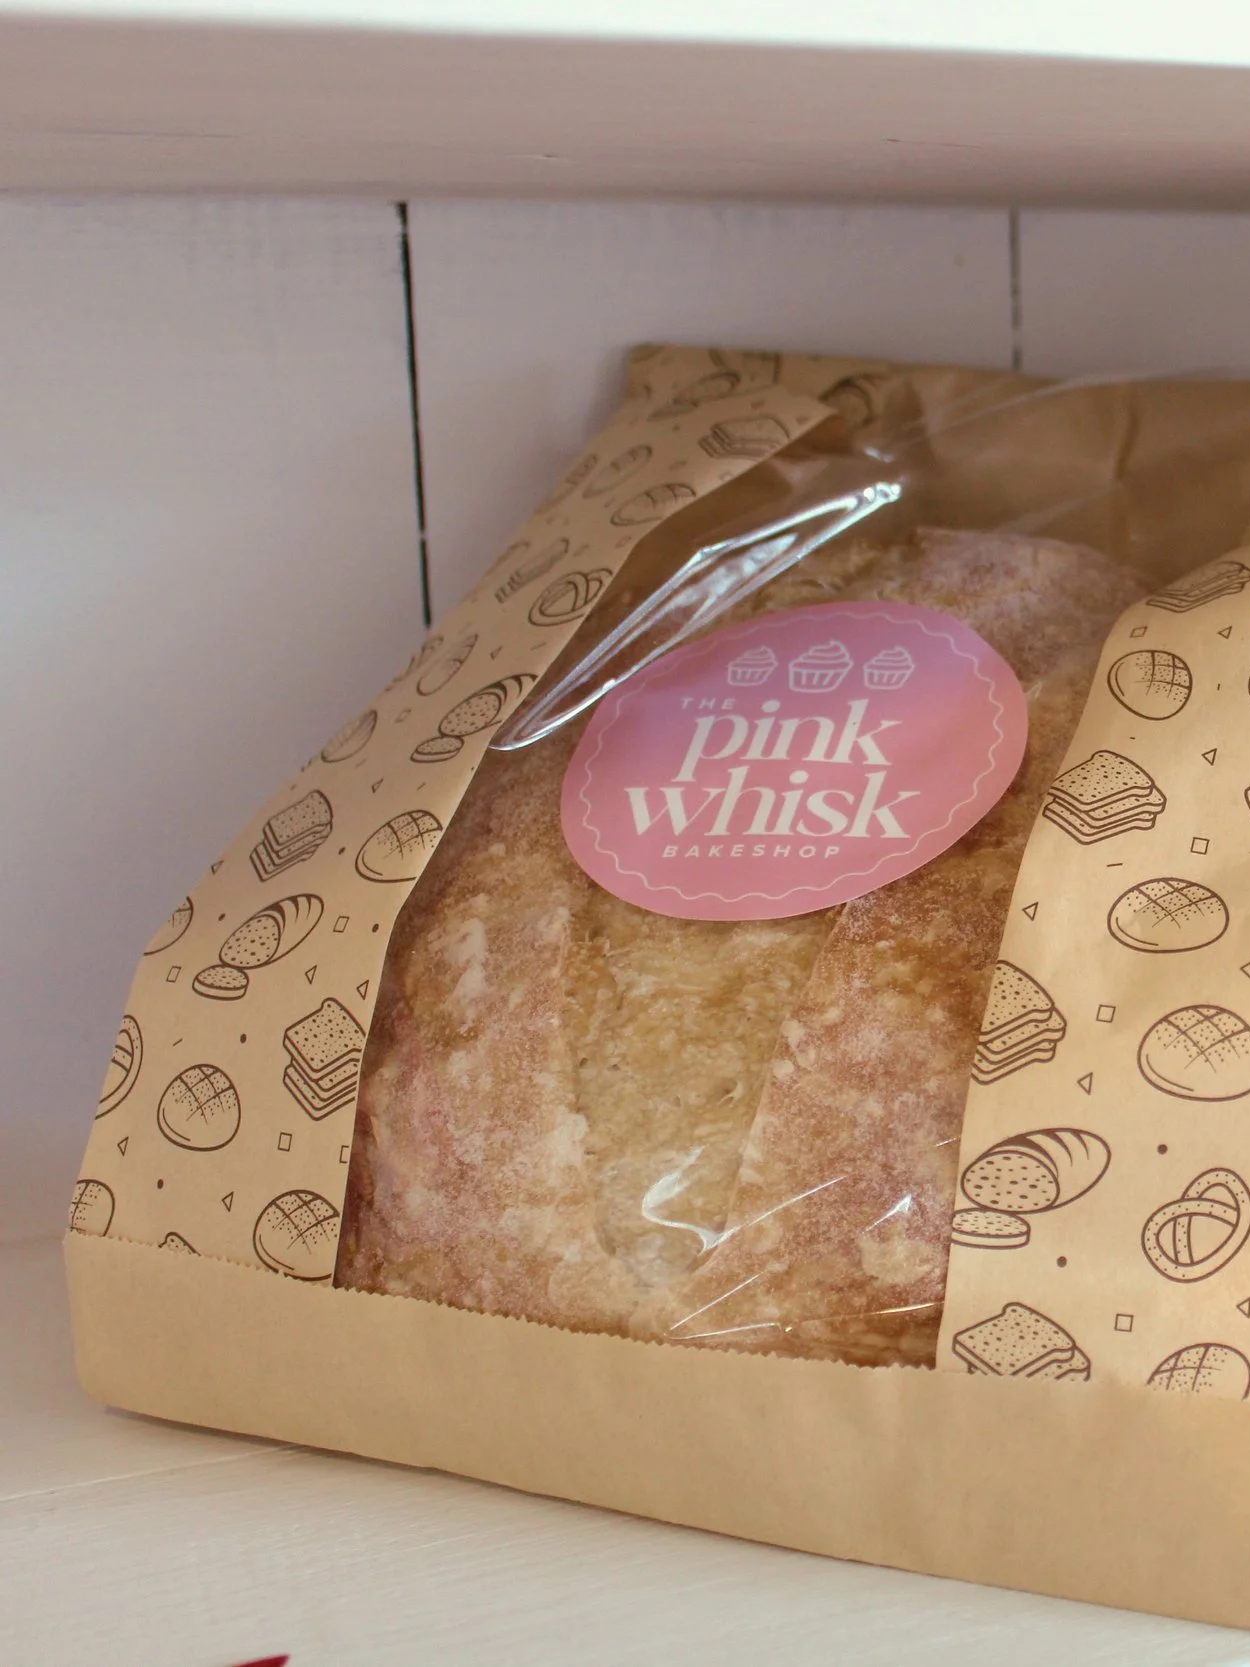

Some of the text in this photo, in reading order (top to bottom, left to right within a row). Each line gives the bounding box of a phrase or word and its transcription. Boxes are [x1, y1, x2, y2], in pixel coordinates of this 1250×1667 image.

[682, 697, 736, 711] THE
[671, 698, 903, 783] pink
[623, 765, 921, 839] whisk
[662, 844, 842, 859] BAKESHOP
